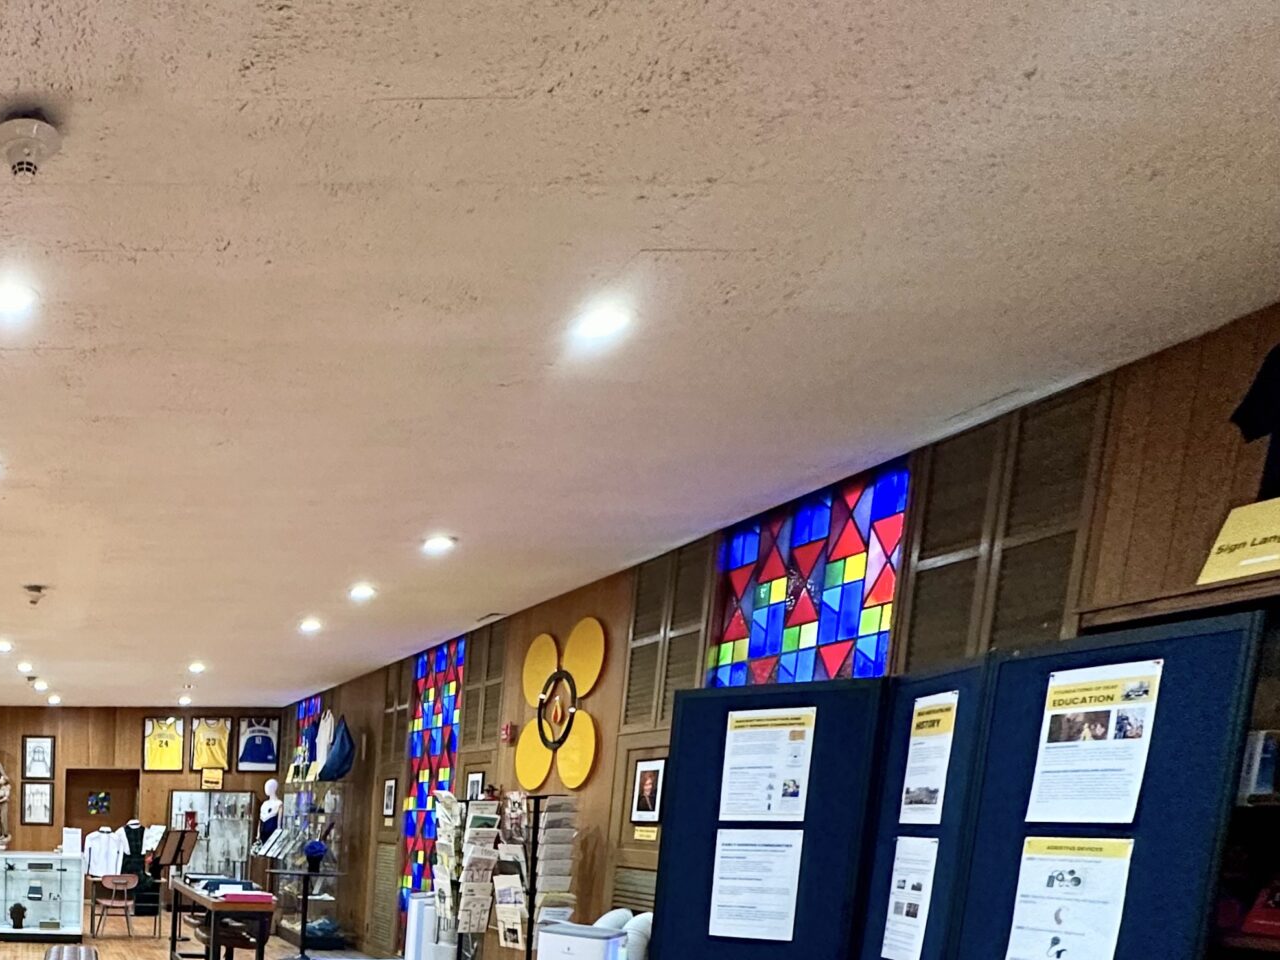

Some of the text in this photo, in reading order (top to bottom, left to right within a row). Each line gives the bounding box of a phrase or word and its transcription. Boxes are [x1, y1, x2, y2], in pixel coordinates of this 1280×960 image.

[1216, 541, 1247, 555] Sign
[1052, 695, 1115, 706] EDUCATION
[915, 718, 941, 730] HISTORY
[158, 739, 169, 748] 24
[205, 737, 216, 746] 23
